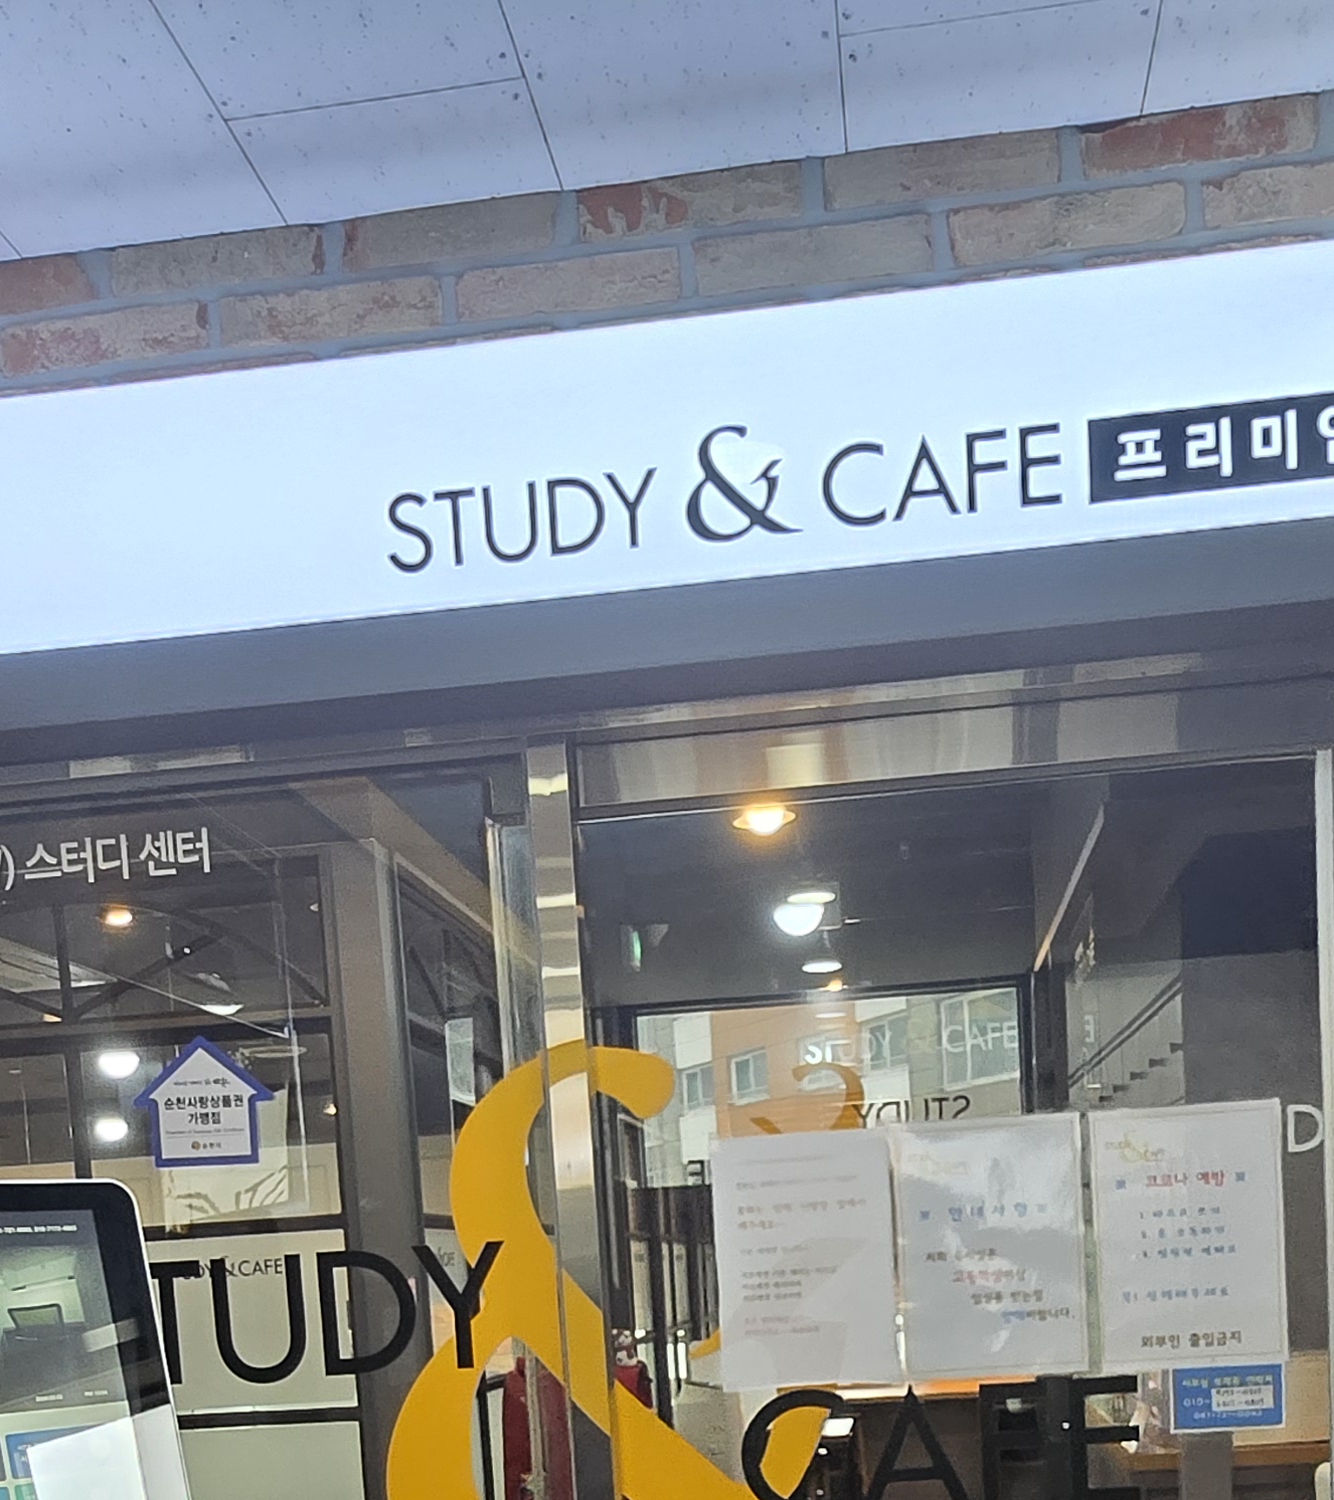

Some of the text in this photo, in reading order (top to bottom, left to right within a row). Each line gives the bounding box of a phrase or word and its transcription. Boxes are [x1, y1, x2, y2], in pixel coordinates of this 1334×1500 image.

[387, 466, 657, 574] STUDY
[685, 423, 803, 542] &
[821, 422, 1063, 526] CAFE
[24, 832, 129, 884] 스터디
[140, 827, 211, 876] 센터
[164, 1093, 243, 1111] 순천사랑상품권
[188, 1111, 221, 1125] 가맹점
[150, 1239, 505, 1386] TUDY
[1141, 1331, 1242, 1349] 외부인 출입금지
